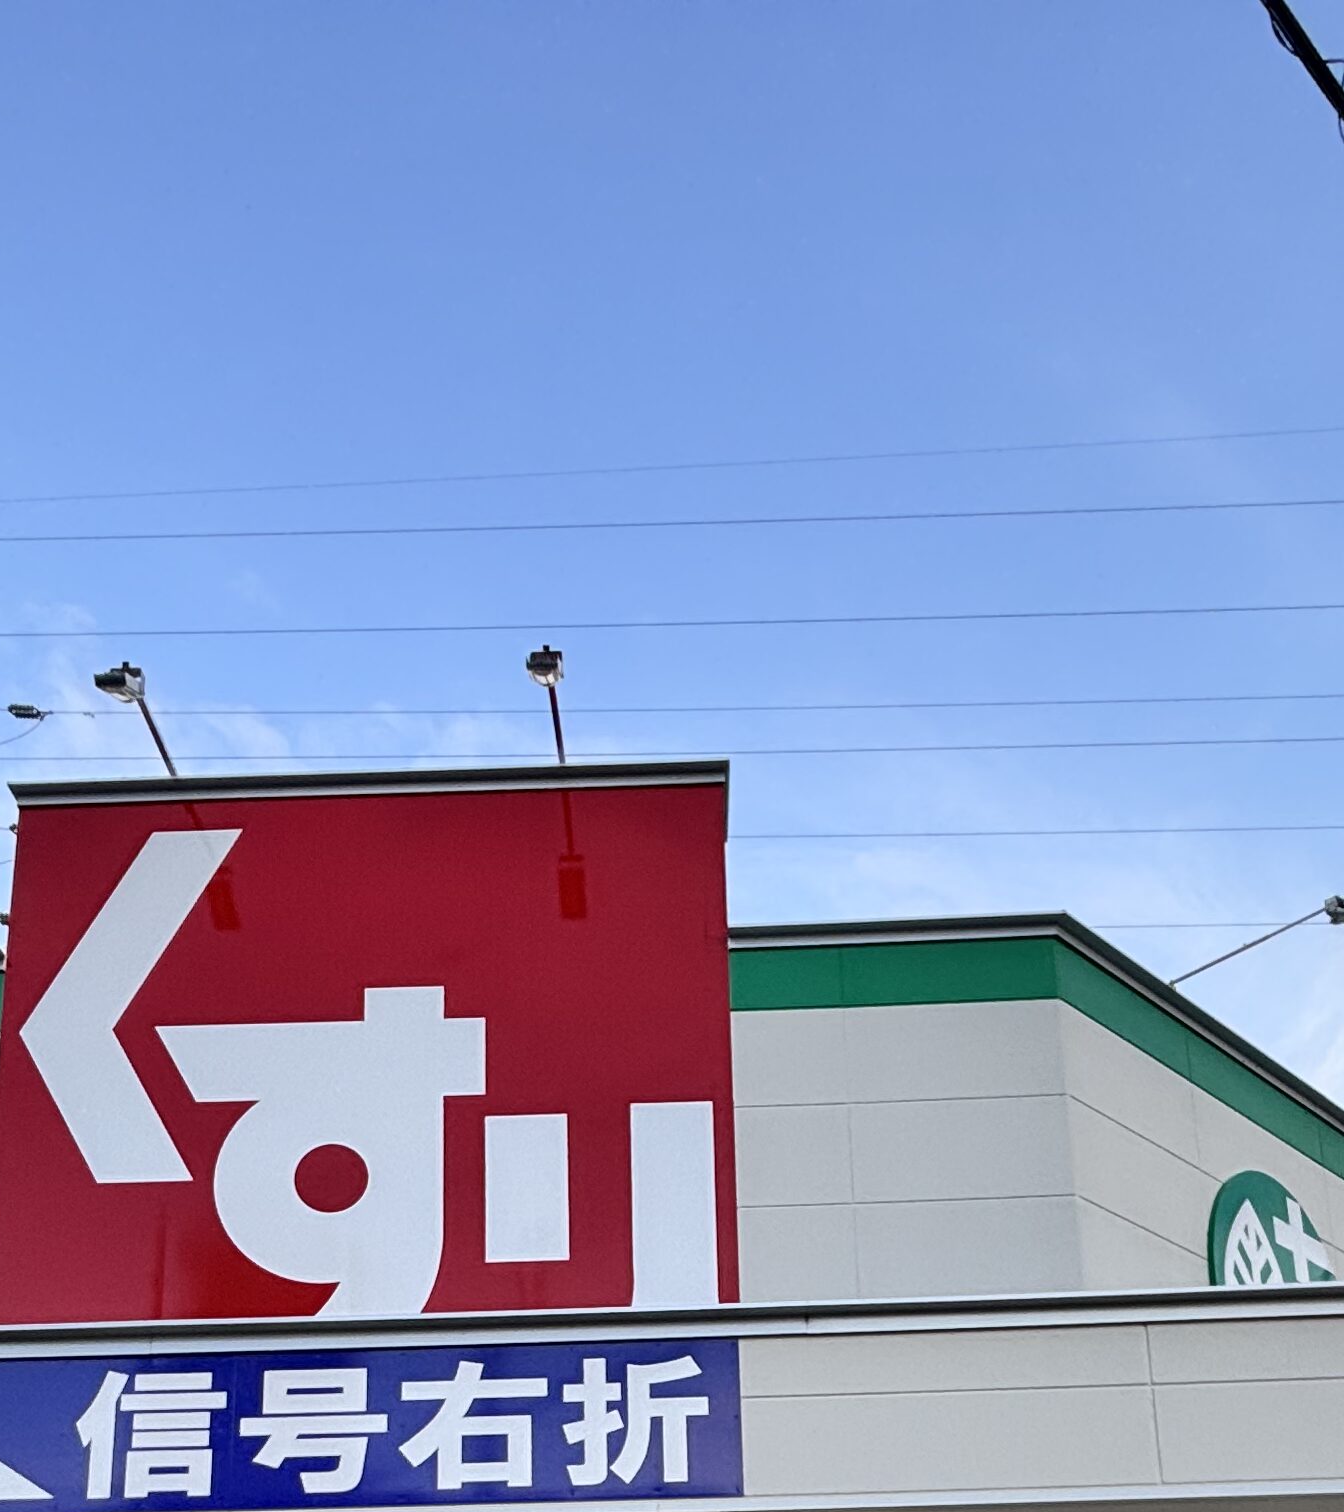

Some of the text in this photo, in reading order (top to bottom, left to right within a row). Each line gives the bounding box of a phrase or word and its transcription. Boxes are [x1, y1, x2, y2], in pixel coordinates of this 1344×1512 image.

[19, 828, 720, 1314] くすり
[77, 1355, 709, 1500] 信号右折
